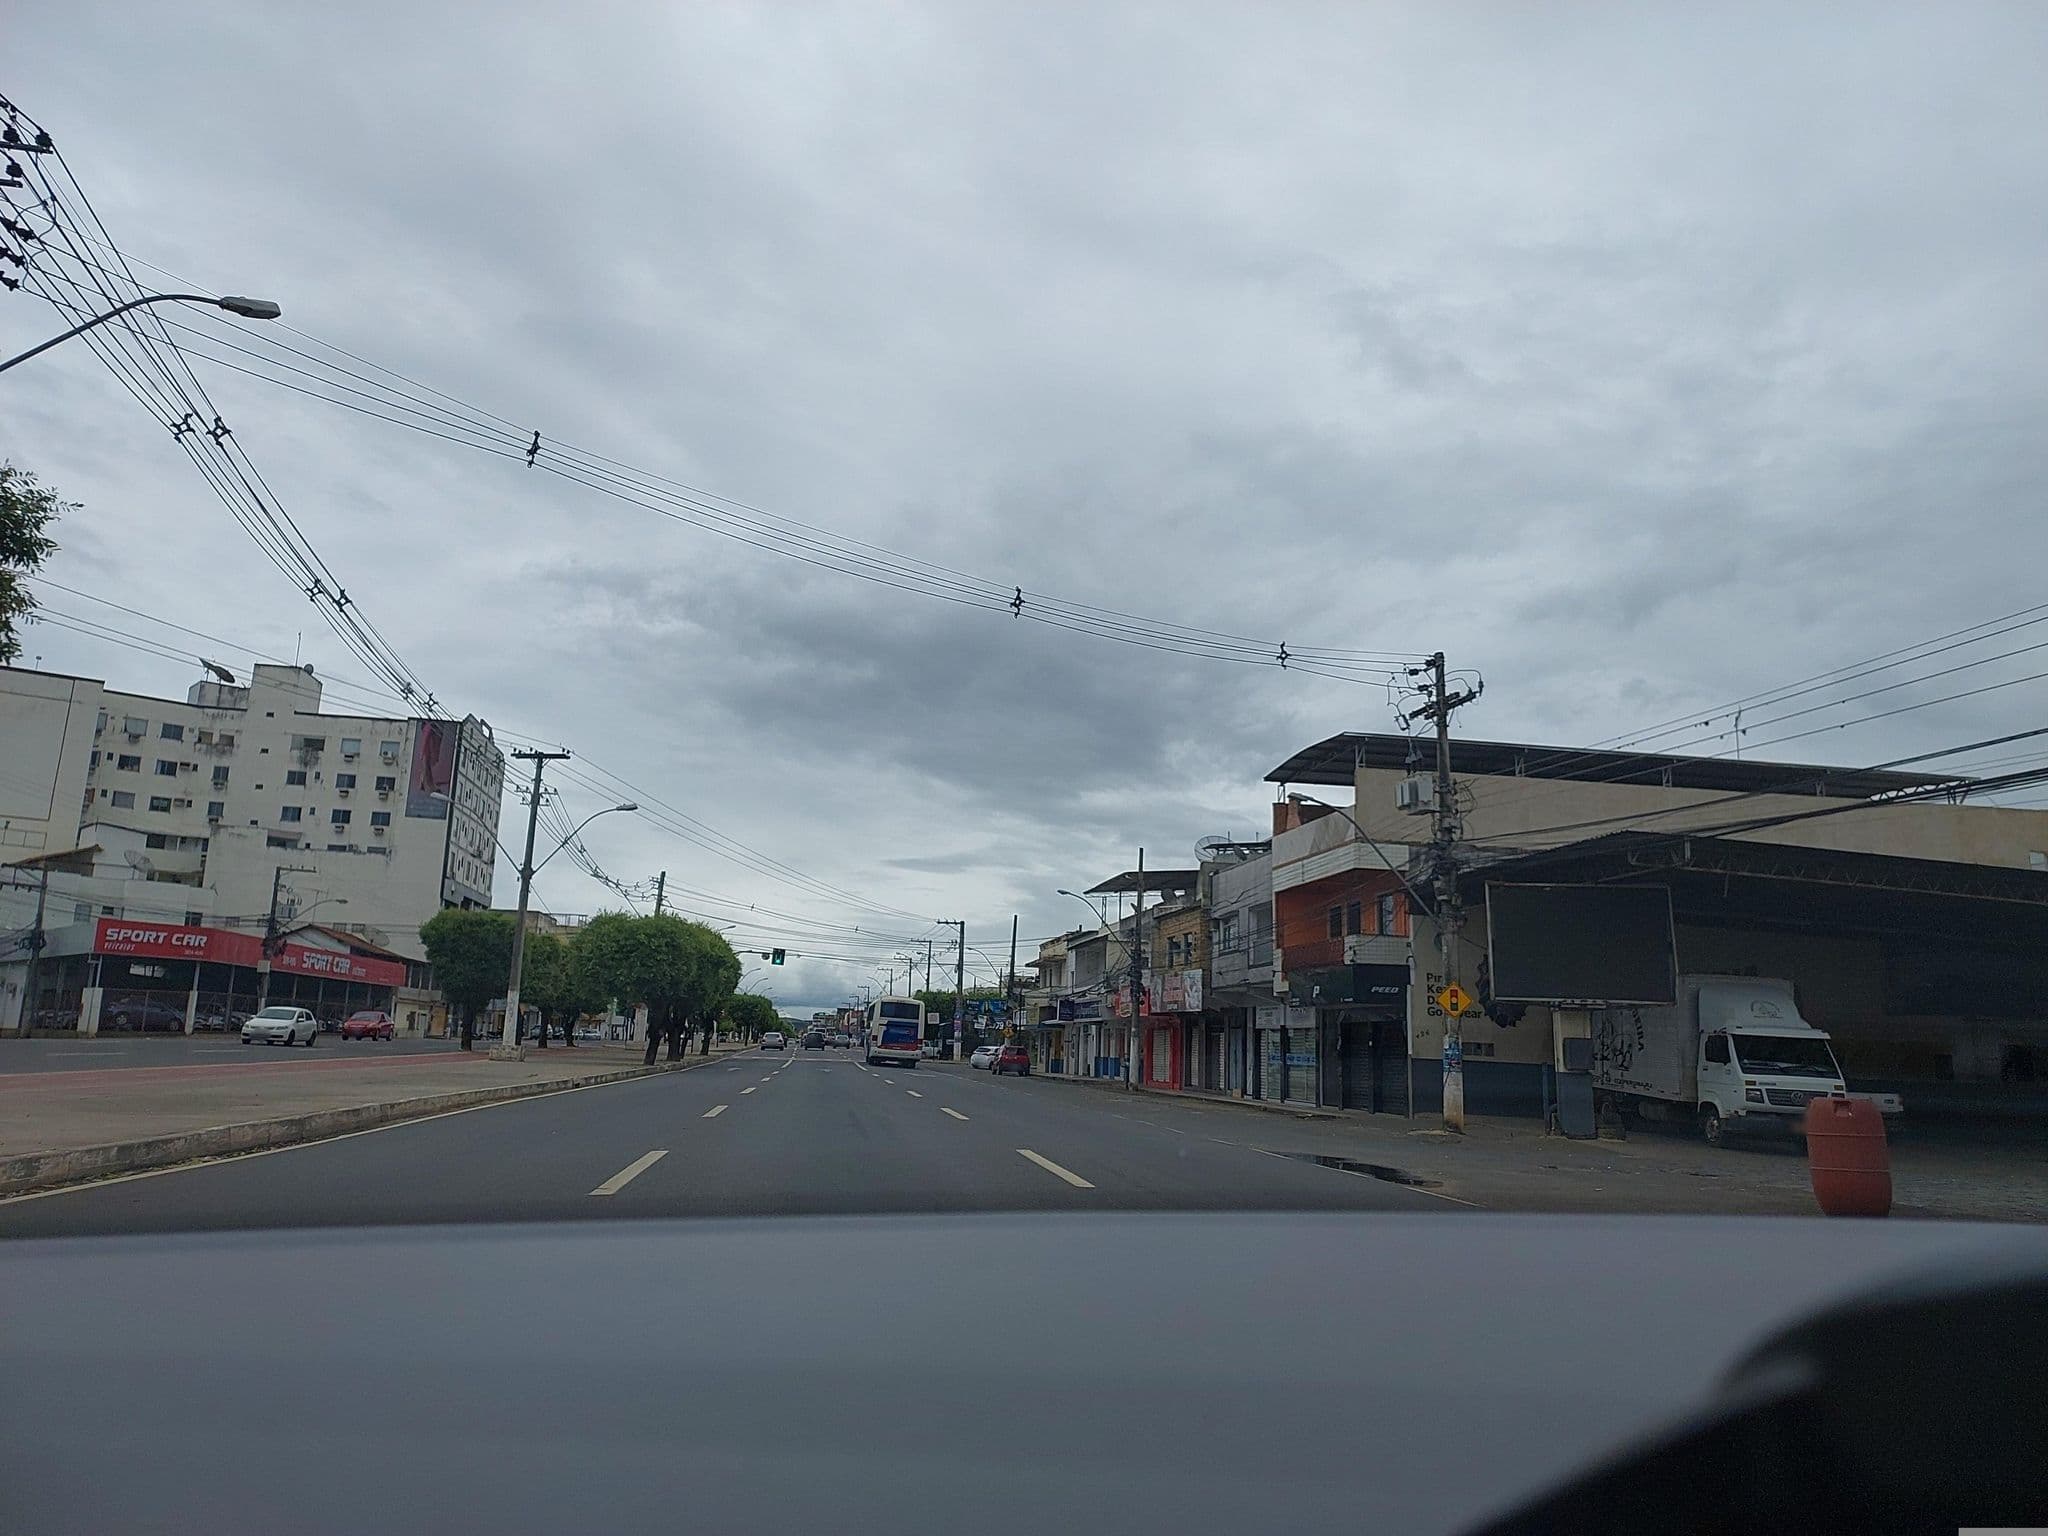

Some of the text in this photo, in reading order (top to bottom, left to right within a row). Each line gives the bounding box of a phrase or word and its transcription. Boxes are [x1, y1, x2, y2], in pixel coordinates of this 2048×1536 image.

[106, 928, 207, 947] SPORT CAR
[302, 952, 333, 971] SPORT
[333, 957, 350, 974] CAR
